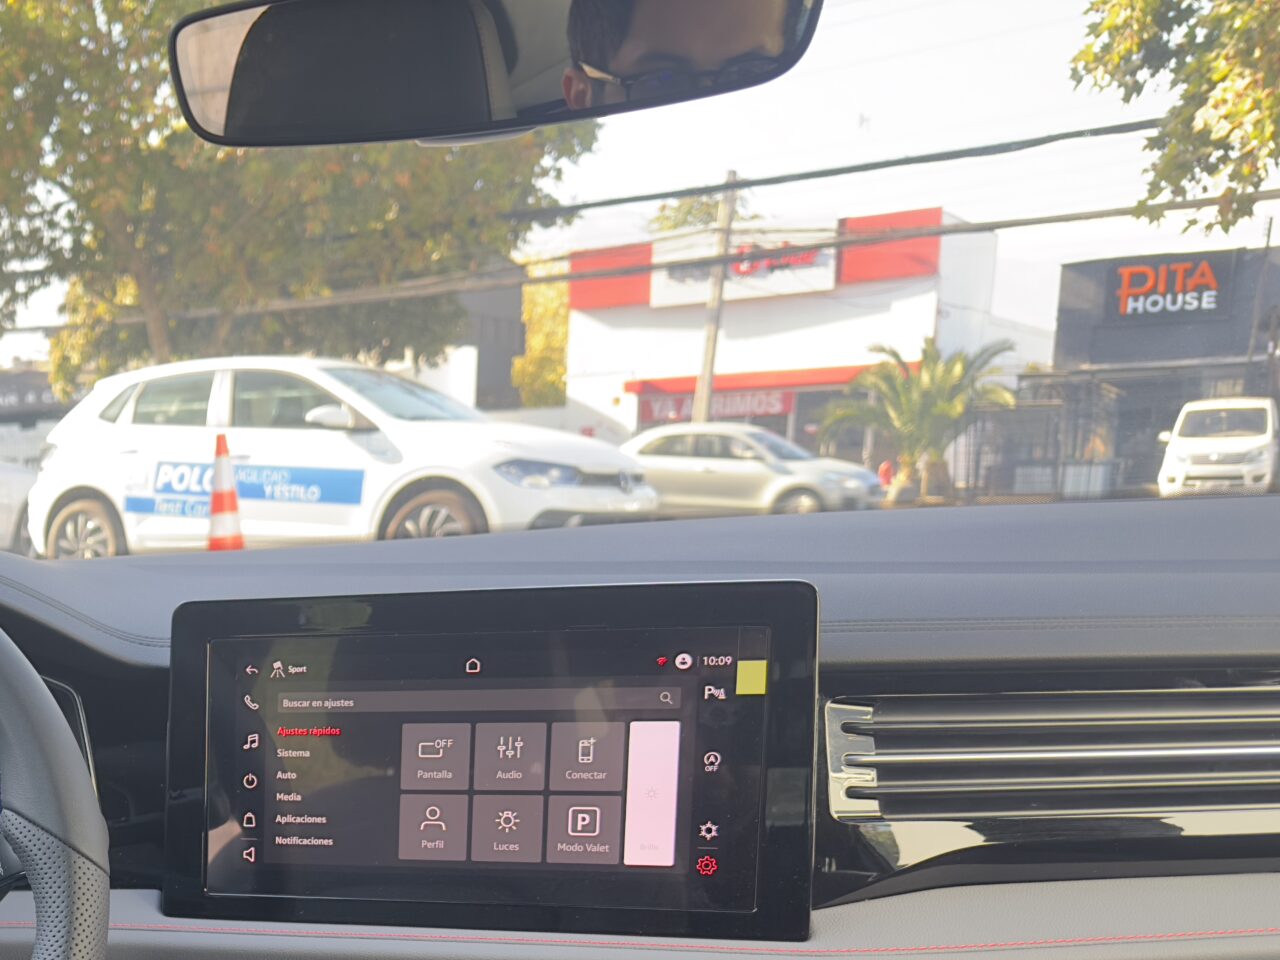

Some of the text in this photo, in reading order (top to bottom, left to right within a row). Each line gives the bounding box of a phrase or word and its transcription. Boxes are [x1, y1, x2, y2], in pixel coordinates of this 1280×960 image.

[1115, 260, 1219, 315] PITA
[1127, 290, 1218, 314] HOUSE
[679, 390, 783, 418] ARIMOS
[702, 656, 733, 666] 10:09
[287, 665, 308, 674] Sport
[282, 699, 354, 709] Buscar en ajustes
[277, 727, 341, 737] Ajustes rápidos
[434, 739, 454, 749] OFF
[276, 749, 310, 758] Sistema
[276, 771, 297, 779] Auto
[417, 770, 453, 779] Pantalla
[496, 770, 523, 779] Audio
[565, 770, 608, 780] Conectar
[276, 793, 302, 801] Media
[275, 815, 327, 825] Aplicaciones
[275, 836, 334, 846] Notificaciones
[421, 840, 444, 849] Perfil
[493, 842, 519, 851] Luces
[557, 843, 610, 852] Modo Valet
